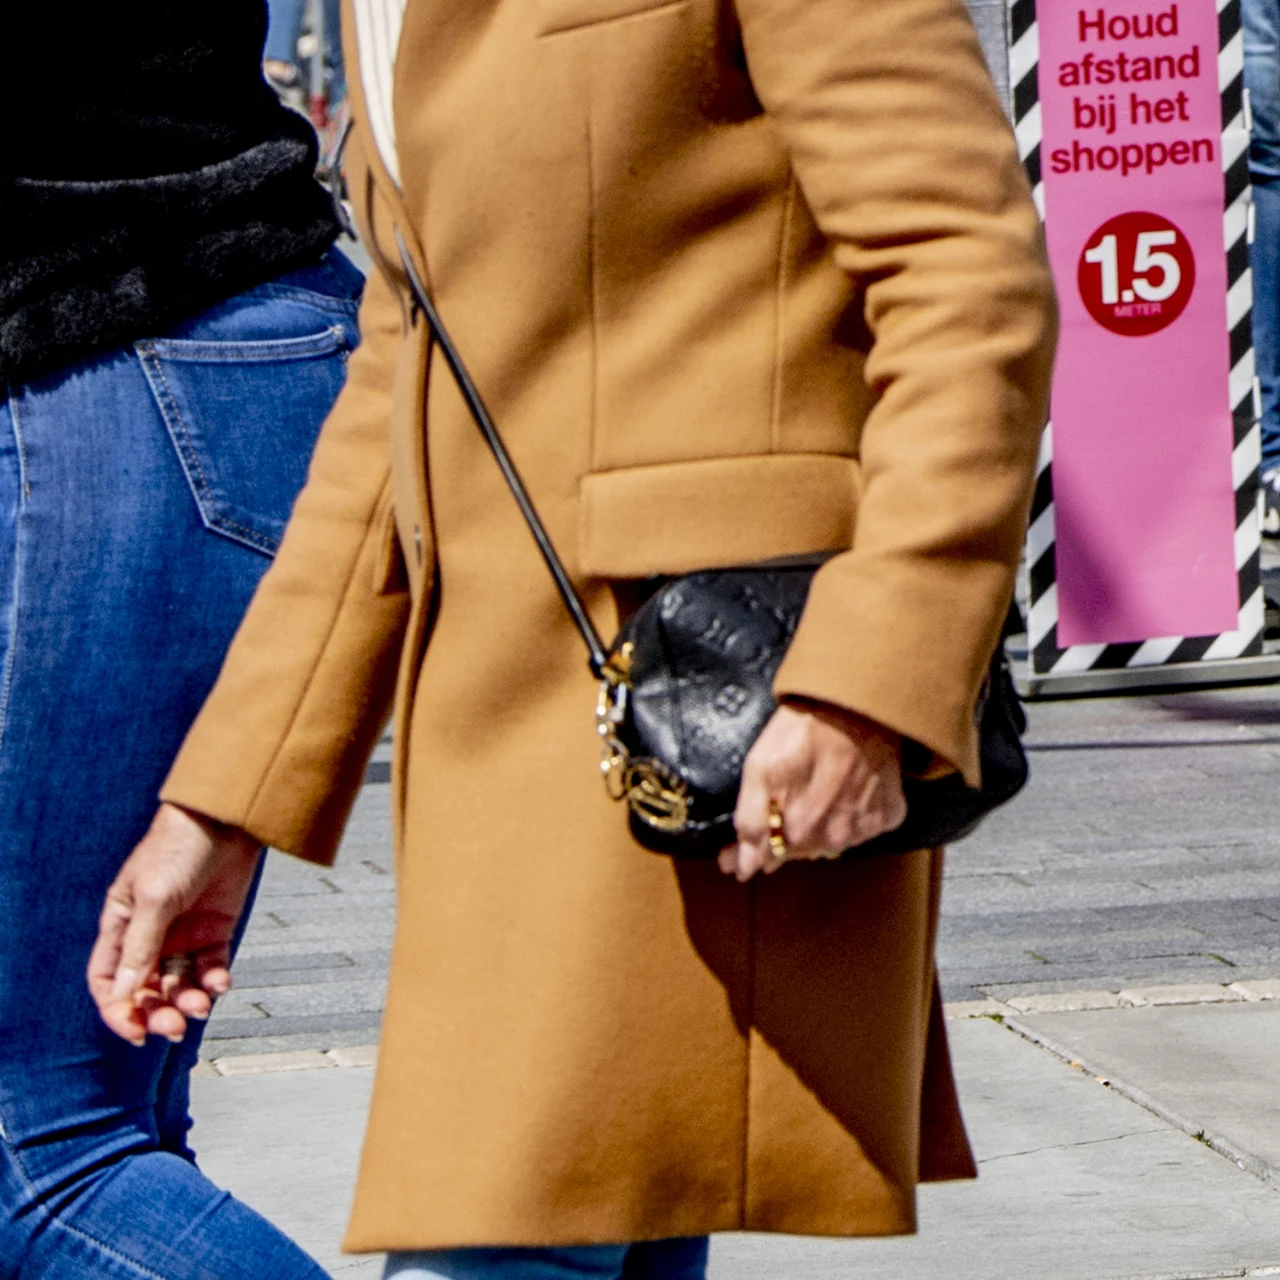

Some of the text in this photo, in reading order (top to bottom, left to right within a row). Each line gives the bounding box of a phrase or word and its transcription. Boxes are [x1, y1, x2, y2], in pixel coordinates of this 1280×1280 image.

[1078, 4, 1178, 42] Houd
[1058, 45, 1200, 87] afstand
[1074, 91, 1190, 135] bij het
[1051, 138, 1214, 177] shoppen
[1084, 230, 1181, 304] 1.5
[1113, 302, 1163, 318] METER
